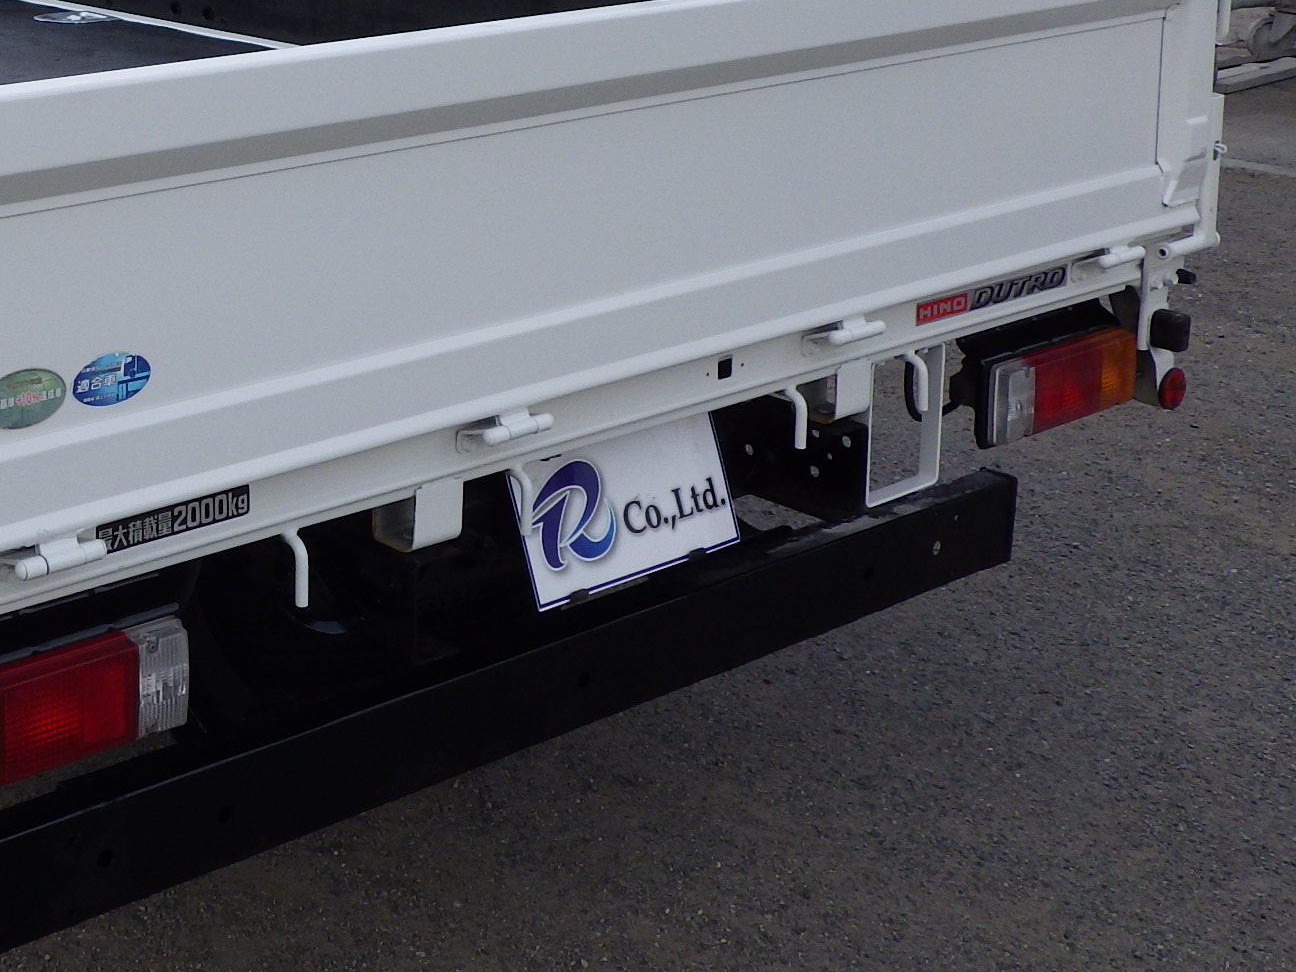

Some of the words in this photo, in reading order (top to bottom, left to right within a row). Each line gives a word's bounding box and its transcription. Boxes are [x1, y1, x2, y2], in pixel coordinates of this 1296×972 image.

[918, 296, 966, 321] HINO
[970, 266, 1067, 311] DUTRO
[75, 374, 117, 394] 適合車
[622, 476, 726, 534] Co.,Ltd.
